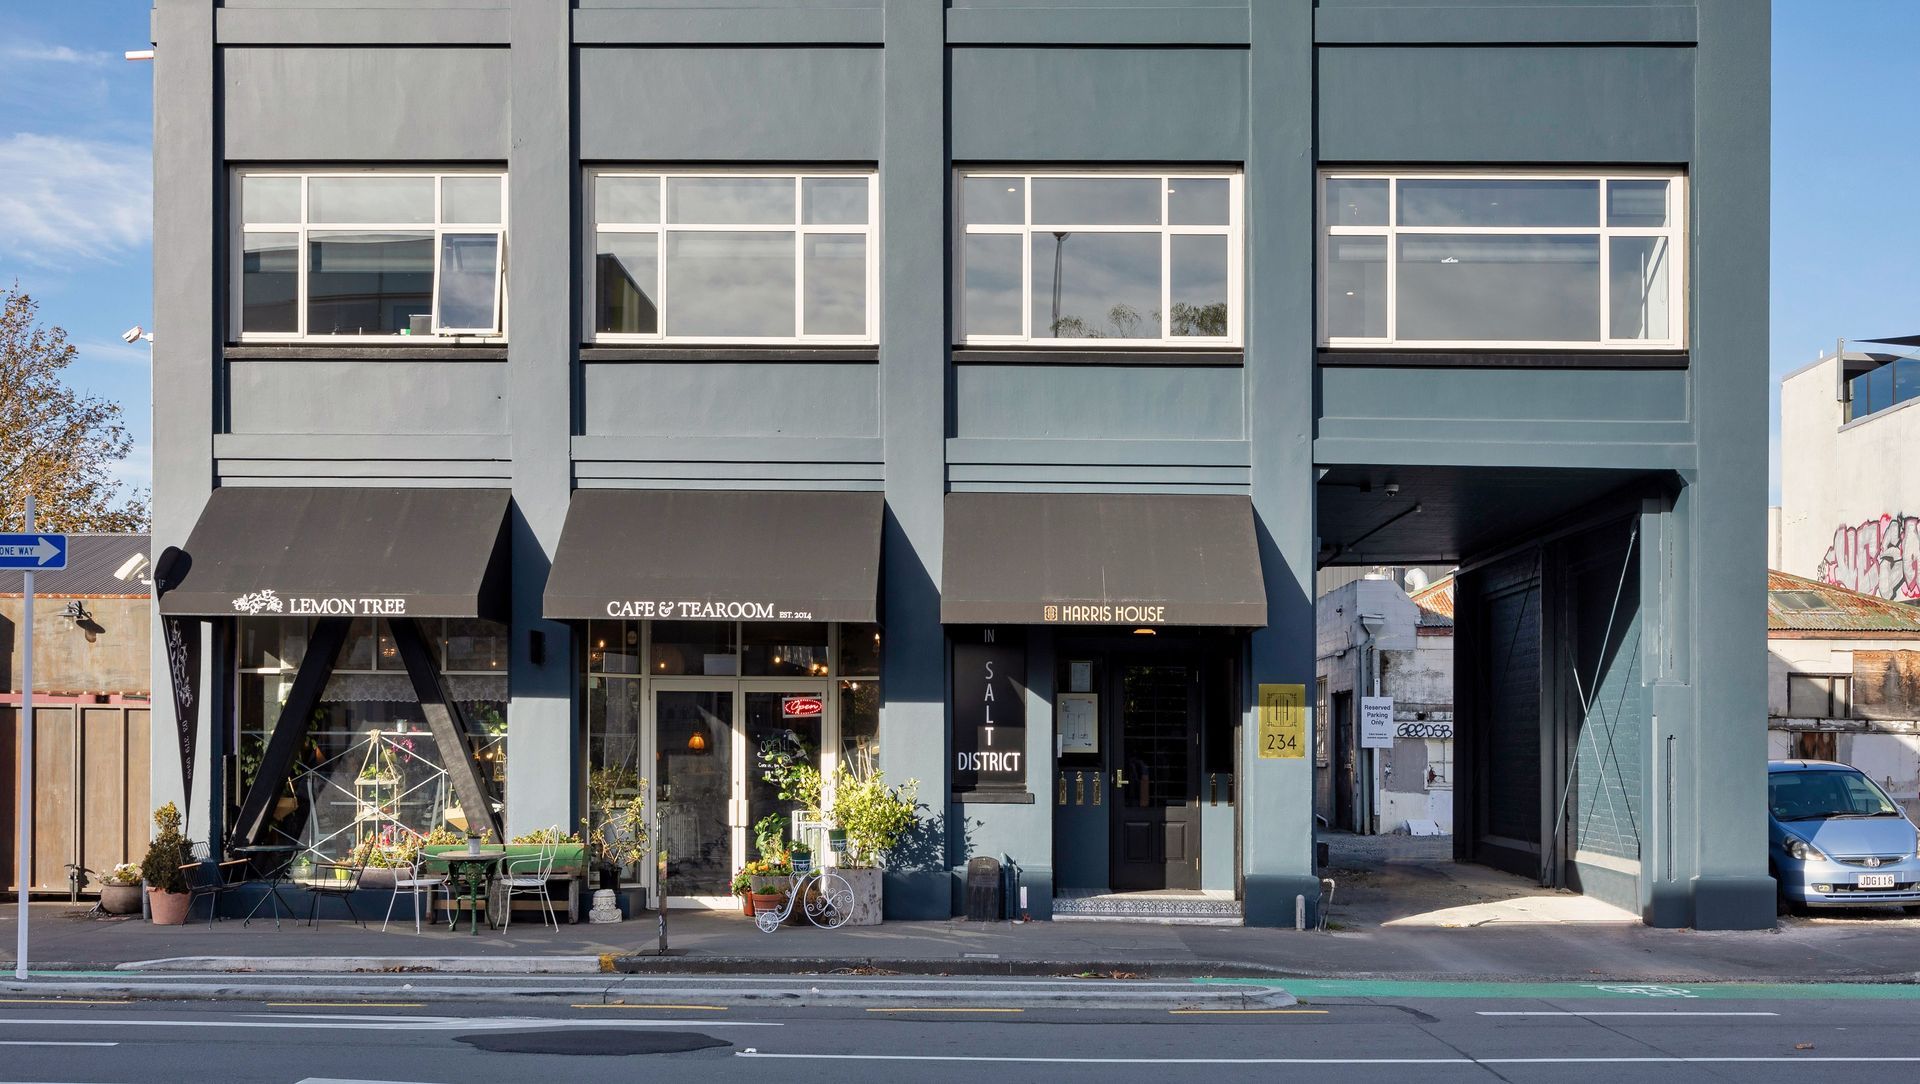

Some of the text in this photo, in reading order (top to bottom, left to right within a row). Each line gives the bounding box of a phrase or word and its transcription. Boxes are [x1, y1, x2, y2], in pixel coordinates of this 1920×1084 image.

[0, 546, 34, 556] ONE WAY
[289, 597, 406, 616] LEMON TREE
[606, 600, 813, 622] CAFE & TEAROOM EST. 2014
[1062, 605, 1165, 622] HARRIS HOUSE
[984, 628, 995, 643] IN
[790, 699, 820, 714] Open
[984, 660, 995, 747] SALT
[1364, 703, 1391, 711] Reserved
[1366, 711, 1389, 719] Parking
[1371, 719, 1385, 727] Only
[1267, 733, 1297, 751] 234
[957, 751, 1021, 772] DISTRICT
[1860, 875, 1894, 887] JDG118
